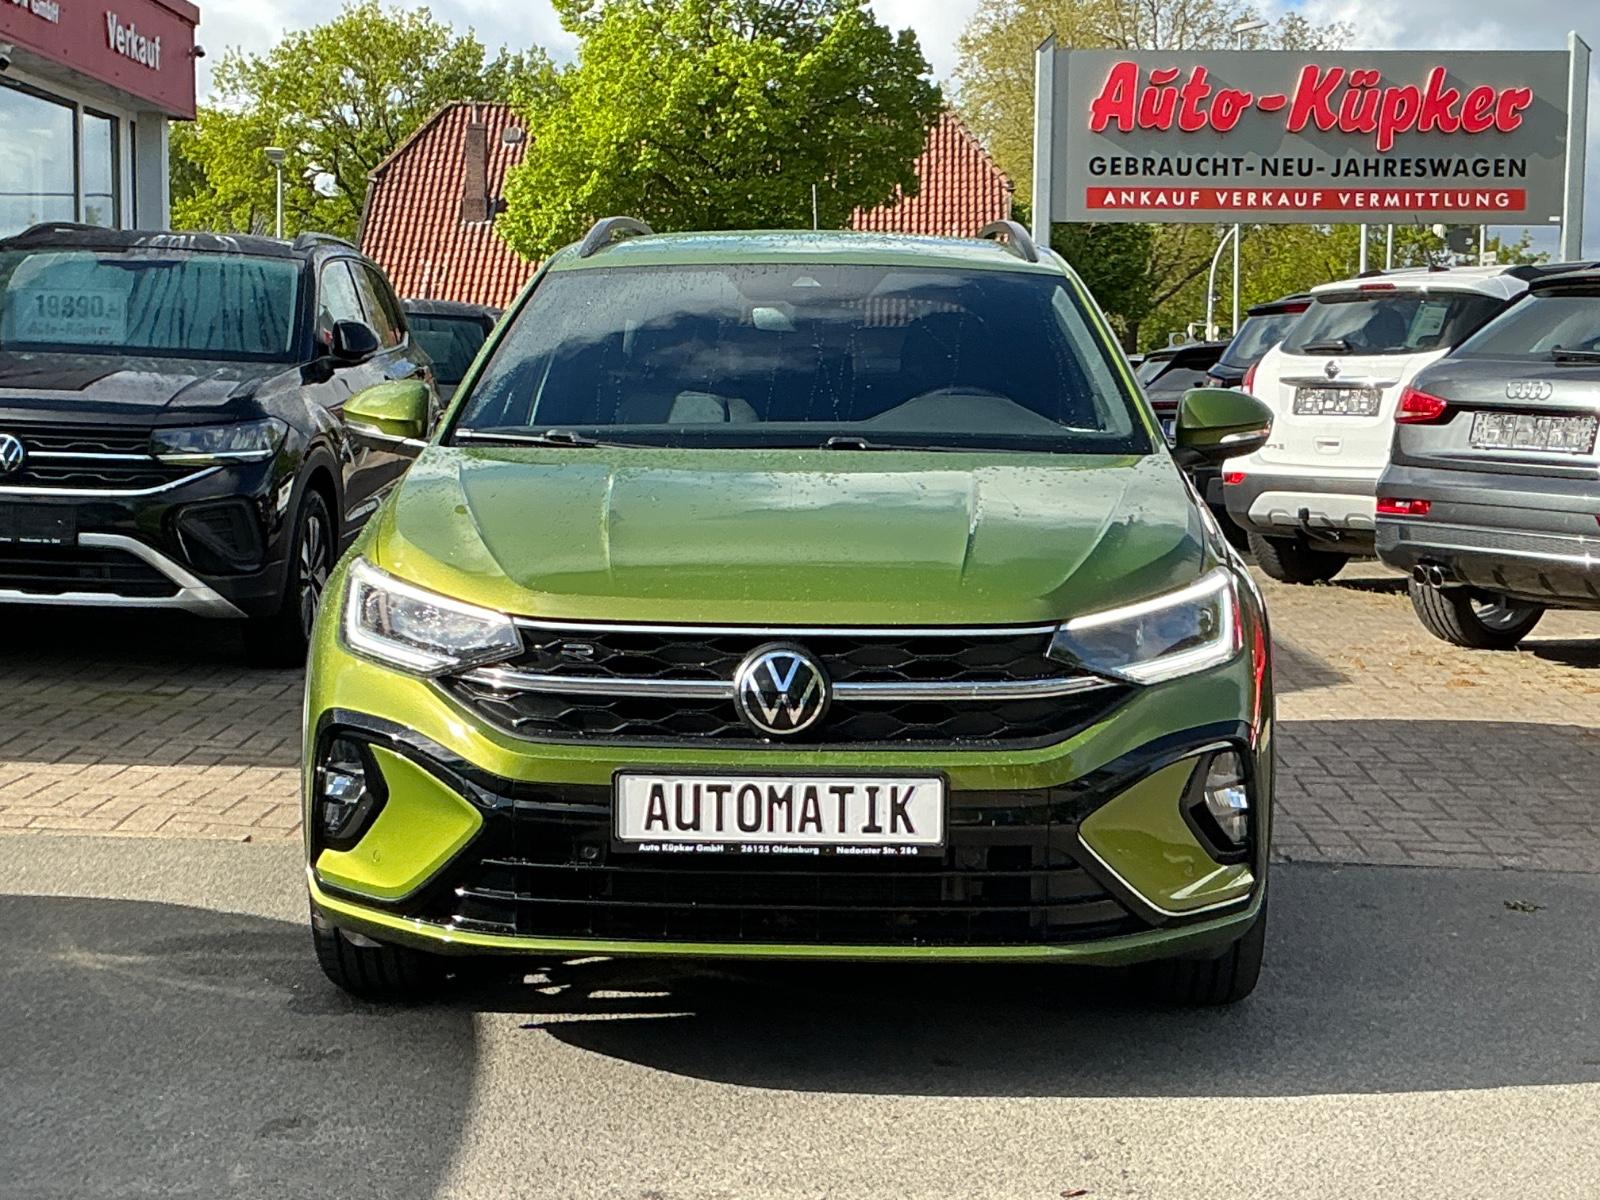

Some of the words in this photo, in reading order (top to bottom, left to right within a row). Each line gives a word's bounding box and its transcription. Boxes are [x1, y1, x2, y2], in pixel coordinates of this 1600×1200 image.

[105, 10, 161, 71] Verkauf
[1103, 191, 1200, 207] ANKAUF
[1216, 191, 1322, 207] VERKAUF
[1338, 192, 1510, 208] VERMITTLUNG
[644, 784, 916, 833] AUTOMATIK
[639, 843, 660, 852] Auto
[662, 844, 694, 853] Küpker
[696, 844, 724, 852] GmbH
[741, 845, 770, 853] 26125
[772, 845, 819, 855] Oldenburg
[882, 846, 898, 854] Str.
